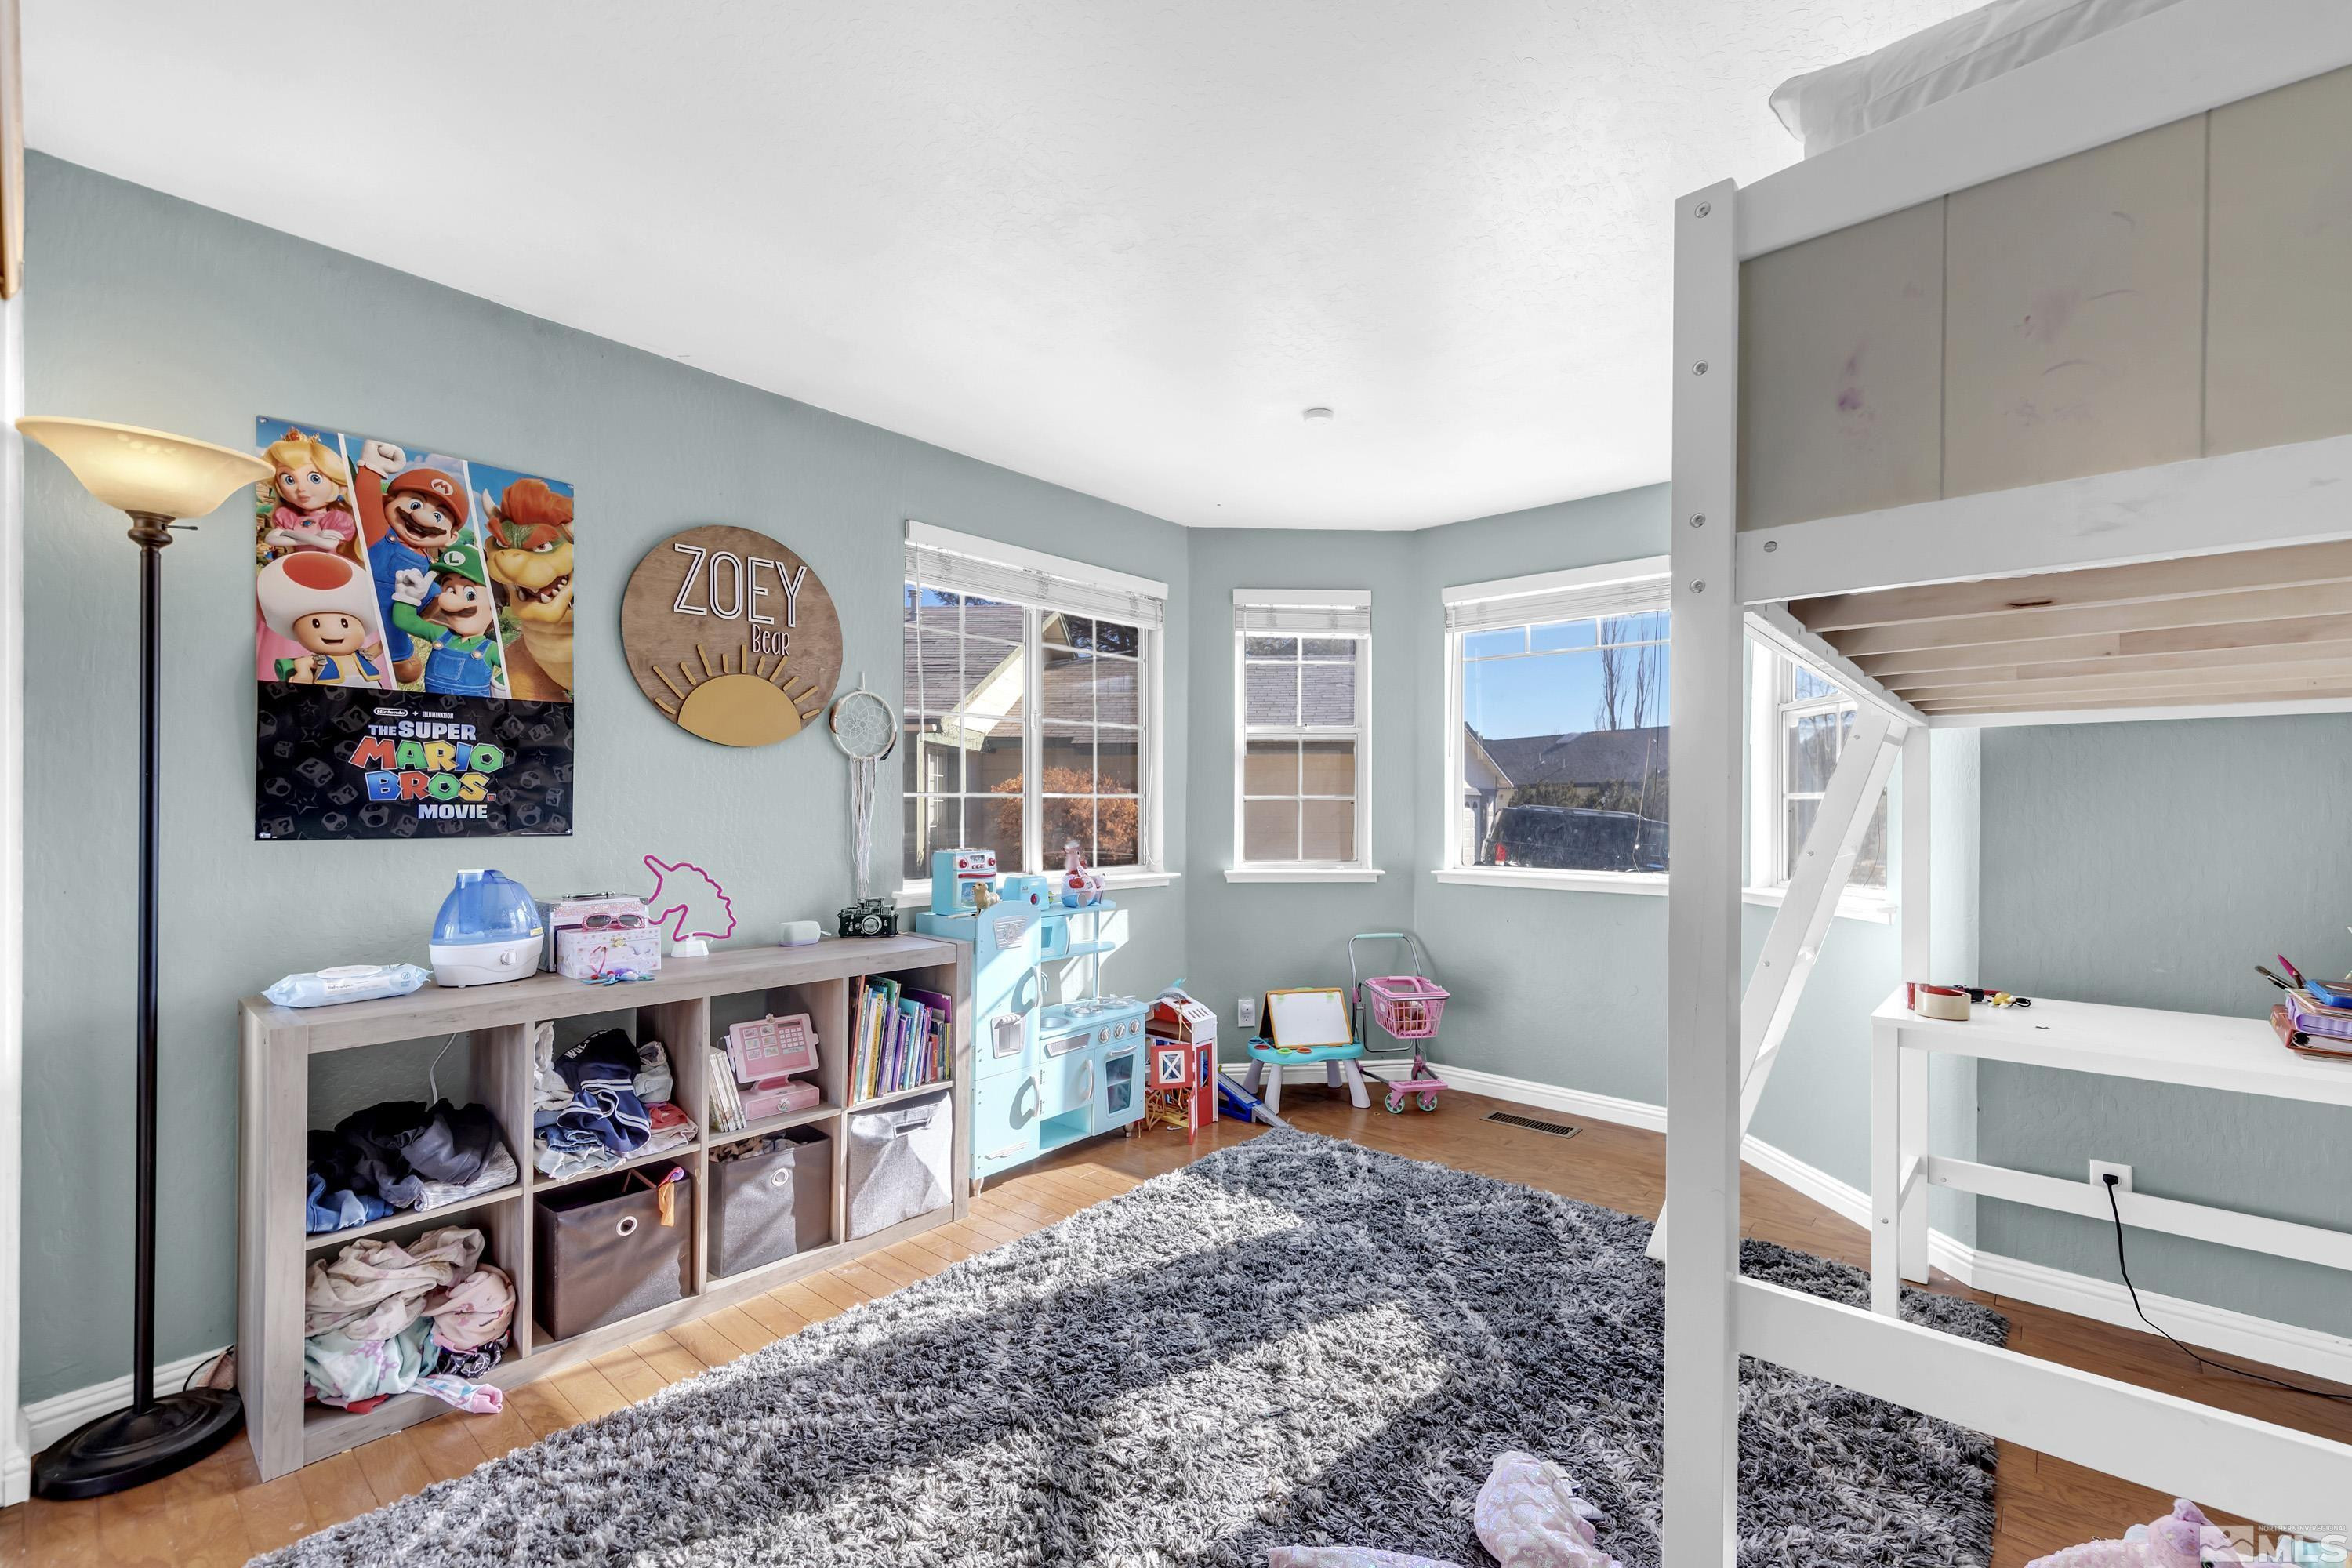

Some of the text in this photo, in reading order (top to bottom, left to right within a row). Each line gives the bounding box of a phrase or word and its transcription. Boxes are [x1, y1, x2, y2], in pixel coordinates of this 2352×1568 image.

[434, 481, 449, 494] M
[449, 552, 459, 564] L
[673, 543, 808, 628] ZOEY
[368, 720, 477, 741] THE SUPER
[348, 735, 505, 774] MARIO
[365, 770, 497, 802] BROS.
[418, 804, 488, 820] MOVIE
